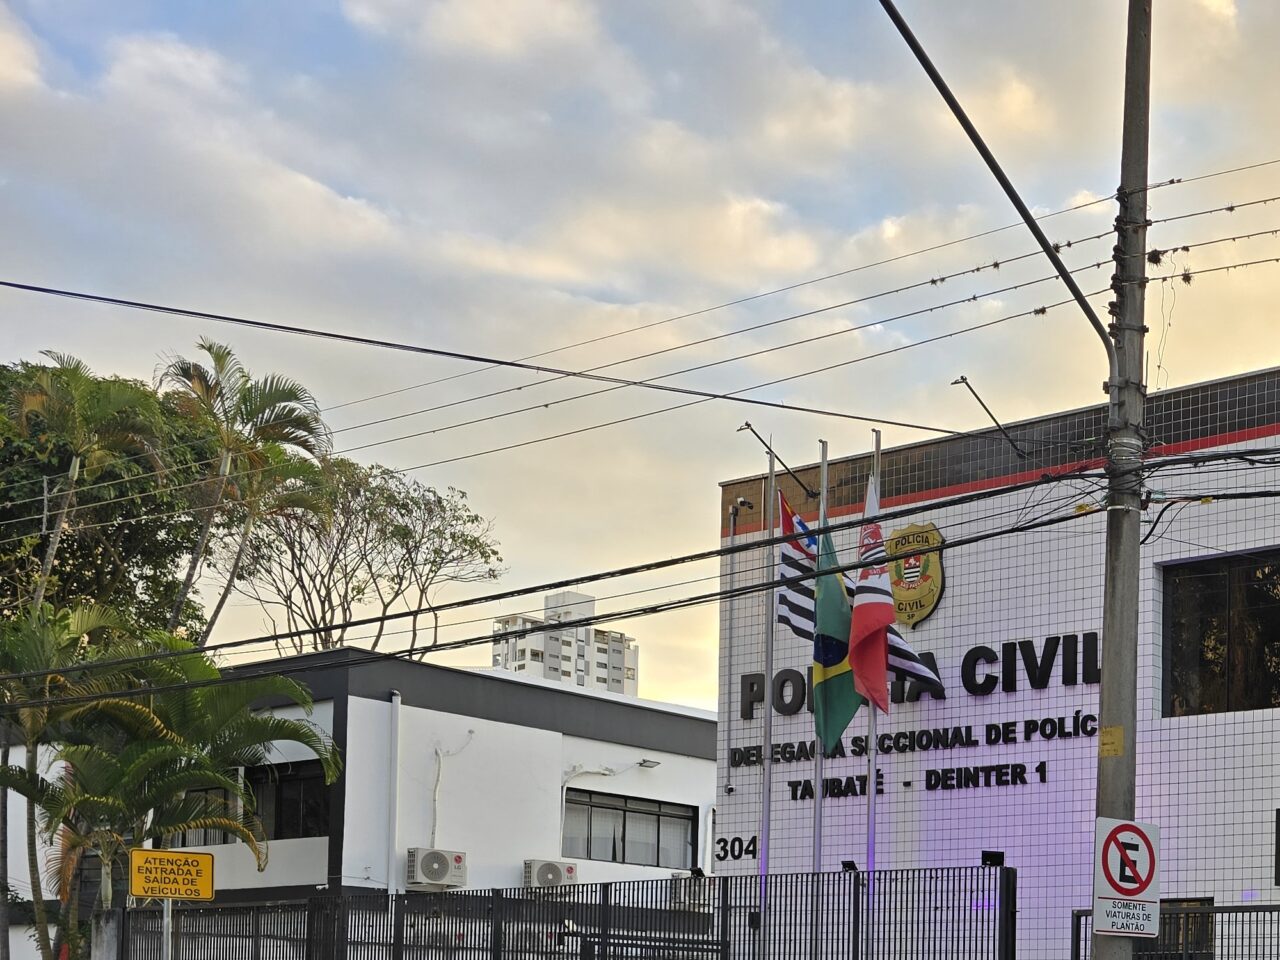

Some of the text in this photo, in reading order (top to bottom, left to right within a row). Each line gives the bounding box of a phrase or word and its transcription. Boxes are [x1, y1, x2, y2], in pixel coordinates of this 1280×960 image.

[897, 600, 925, 611] CIVIL
[961, 631, 1102, 696] CIVIL
[985, 721, 1017, 745] DE
[1024, 709, 1098, 741] POLÍC
[925, 763, 1028, 790] DEINTER
[1035, 761, 1047, 783] 1
[715, 835, 758, 861] 304
[143, 856, 200, 868] ATENÇÃO
[137, 866, 203, 877] ENTRADA E
[182, 878, 198, 886] DE
[1112, 900, 1147, 912] SOMENTE
[1105, 910, 1152, 922] VIATURAS DE
[1111, 921, 1145, 932] PLANTÃO
